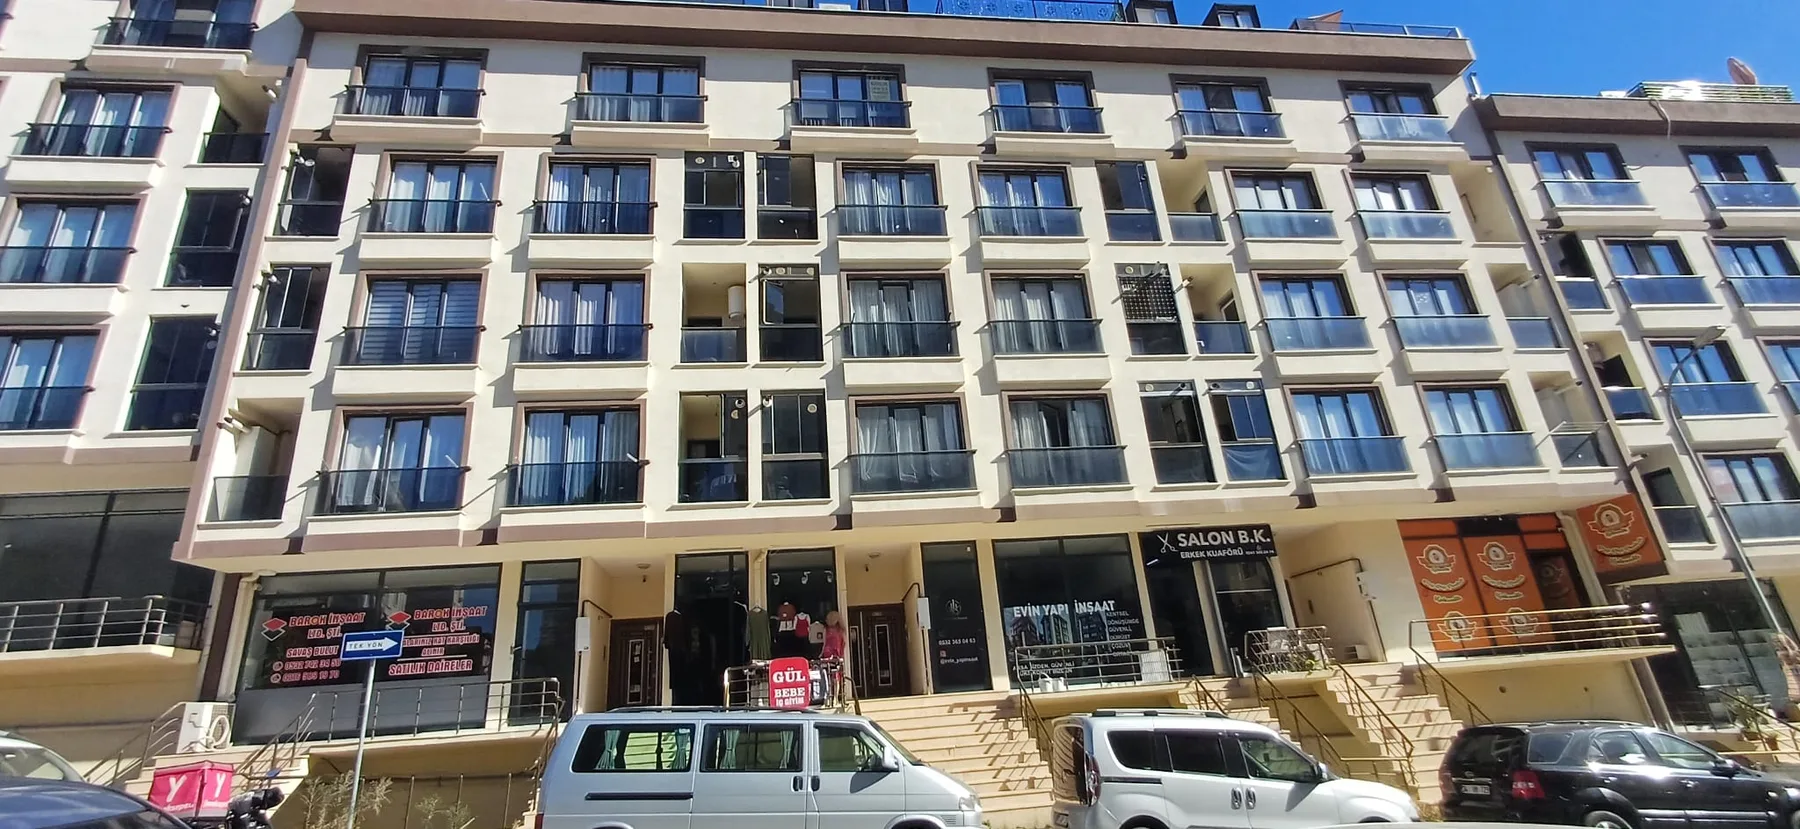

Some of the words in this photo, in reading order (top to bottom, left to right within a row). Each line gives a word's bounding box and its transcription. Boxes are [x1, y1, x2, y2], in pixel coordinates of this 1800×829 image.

[1177, 531, 1235, 547] SALON
[1237, 529, 1271, 543] B.K.
[1180, 550, 1206, 559] ERKEK
[1206, 547, 1244, 557] KUAFÖRÜ
[414, 608, 450, 620] BAROK
[451, 605, 488, 618] İNŞAAT
[1013, 603, 1040, 618] EVİN
[1041, 603, 1069, 616] YAPI
[1074, 599, 1115, 615] İNŞAAT
[288, 615, 327, 627] BAROK
[328, 612, 366, 626] İNŞAAT
[432, 622, 449, 632] LTD.
[449, 620, 466, 632] ŞTİ.
[307, 628, 325, 639] LTD.
[326, 626, 343, 639] ŞTİ.
[1108, 625, 1132, 633] GÜVENLİ
[402, 637, 432, 647] ALARINIZ
[432, 636, 446, 646] KAT
[446, 633, 480, 646] KARŞILIĞI
[286, 648, 313, 658] SAVAŞ
[313, 645, 340, 657] BULUT
[421, 647, 445, 657] ALINIR
[388, 661, 426, 675] SATILIK
[427, 659, 473, 673] DAİRELER
[772, 667, 805, 682] GÜL
[774, 688, 805, 698] BEBE
[785, 697, 805, 705] GİYİM
